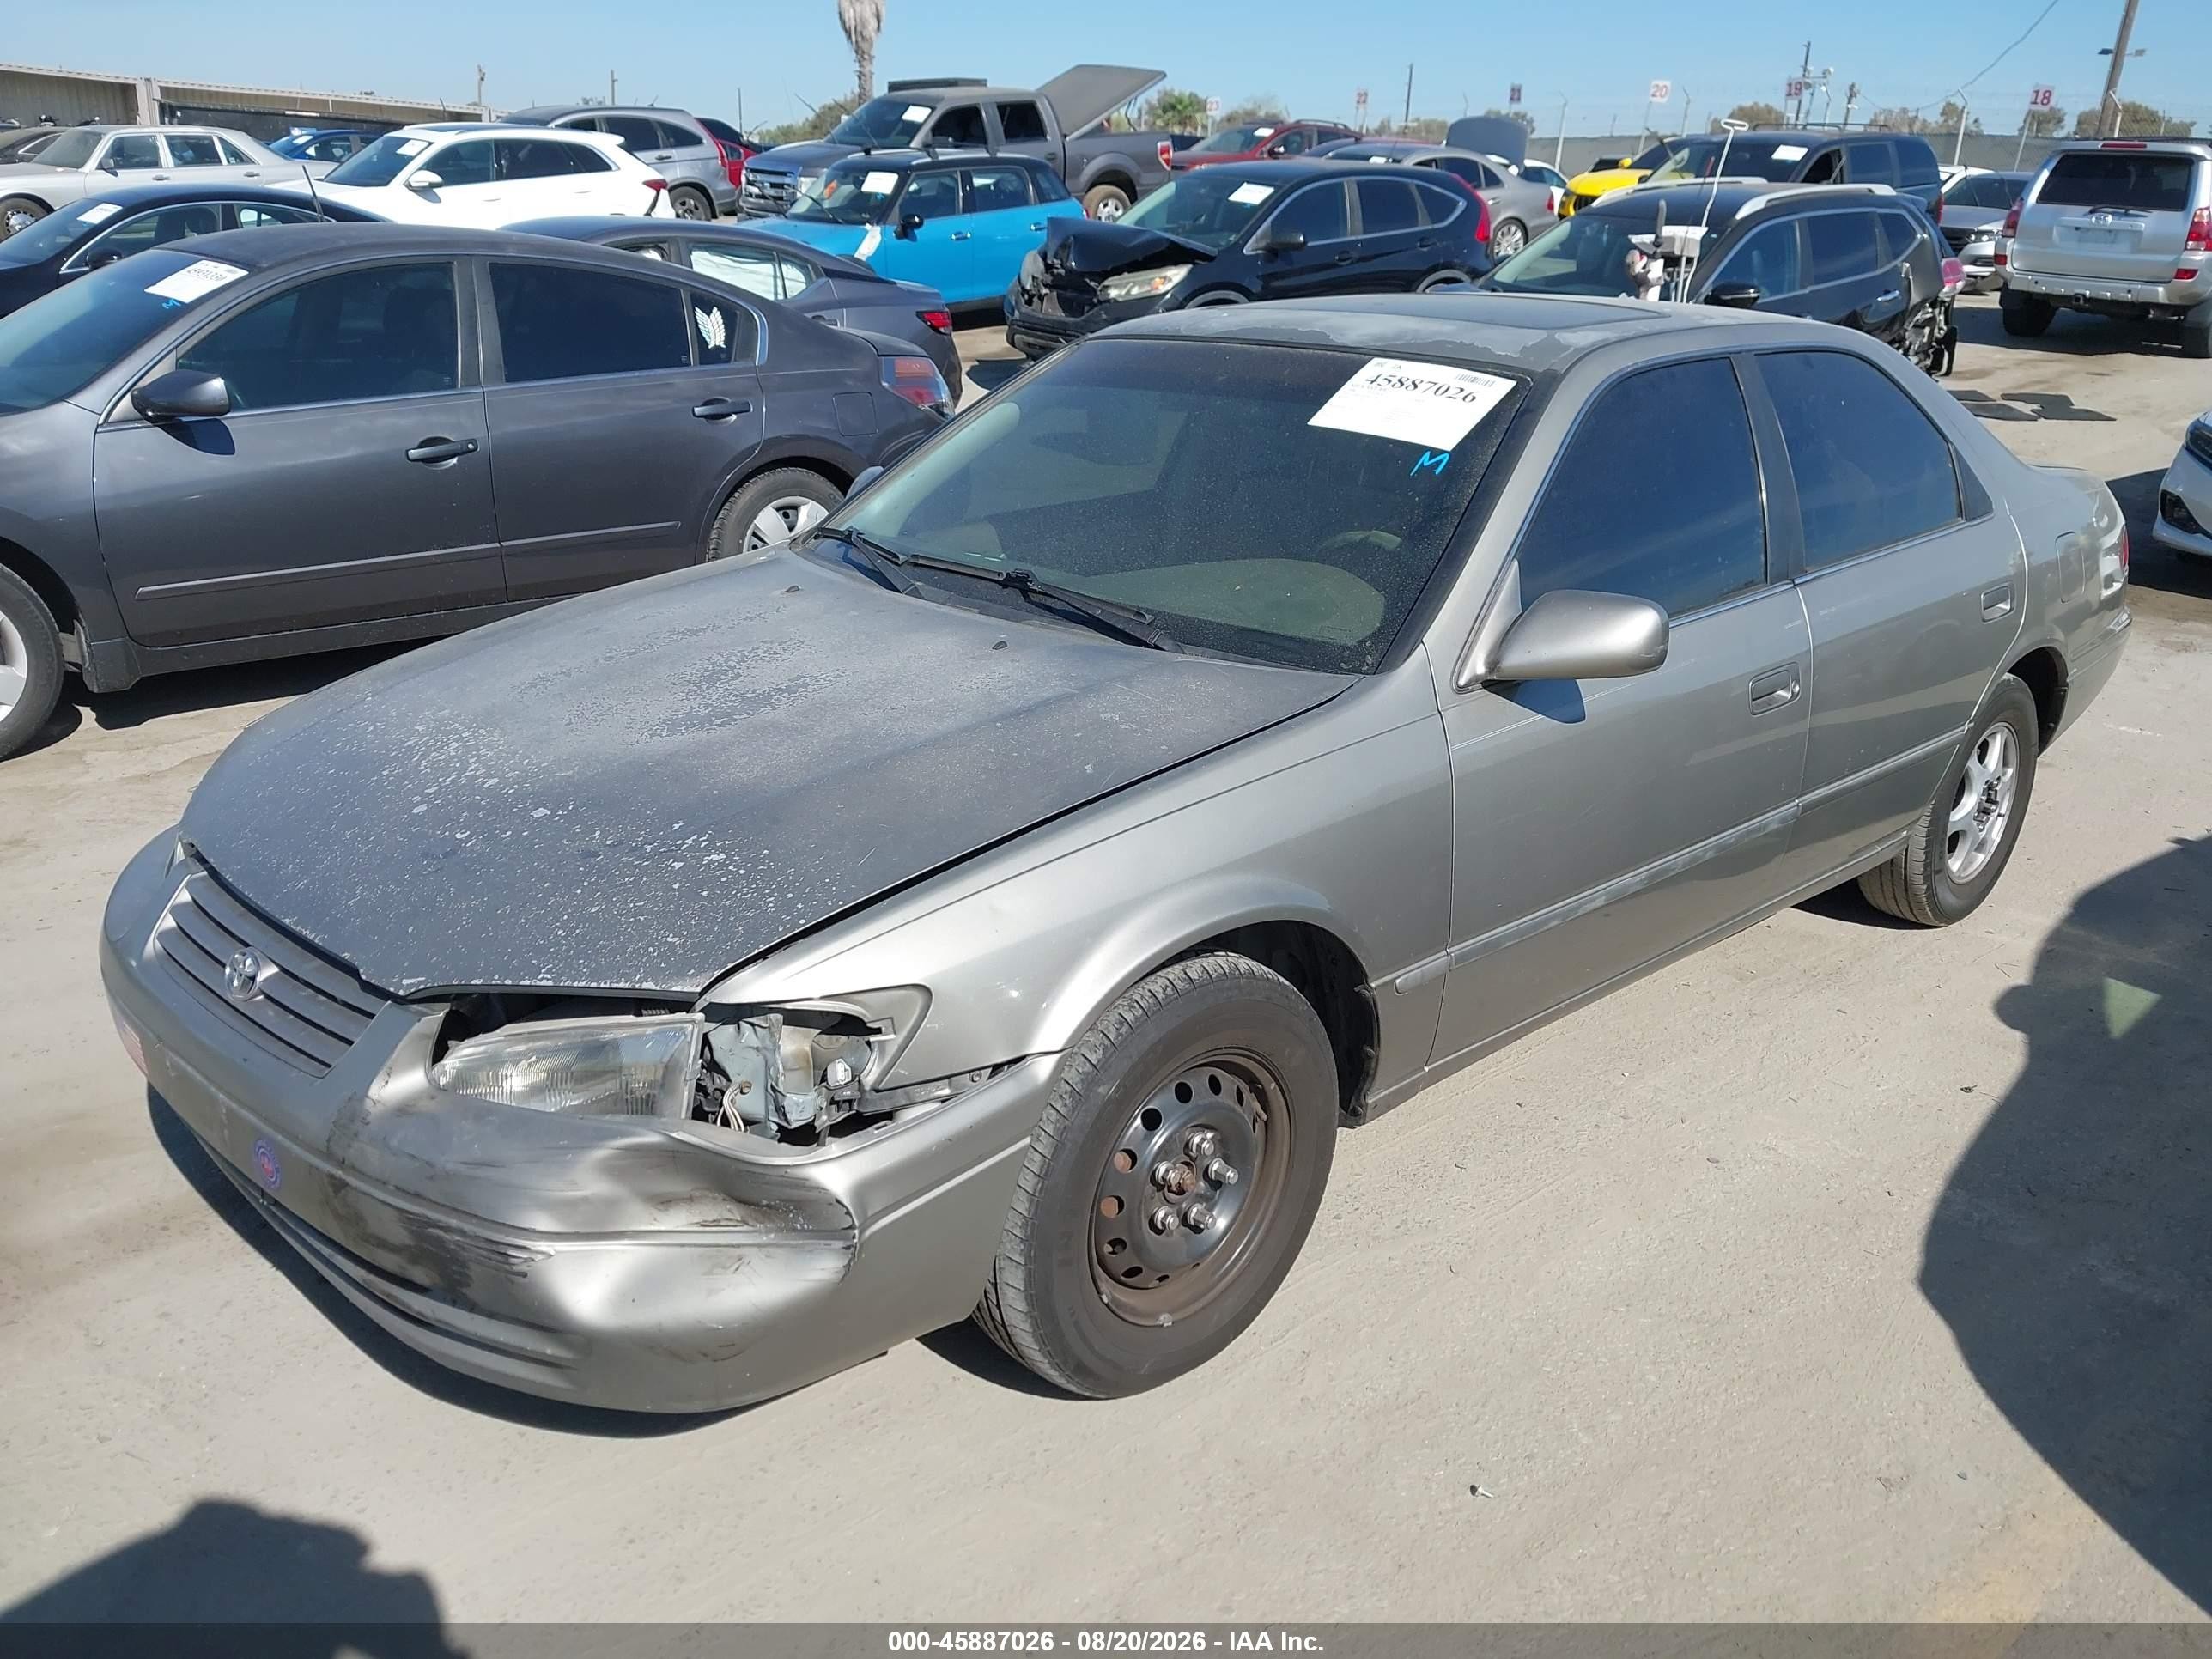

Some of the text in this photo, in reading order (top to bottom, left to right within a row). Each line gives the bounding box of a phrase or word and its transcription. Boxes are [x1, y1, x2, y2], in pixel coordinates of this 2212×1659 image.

[1650, 83, 1668, 99] 20
[1785, 81, 1803, 97] 19
[2029, 88, 2052, 106] 18
[1364, 372, 1479, 404] 45887026
[1409, 450, 1451, 477] M
